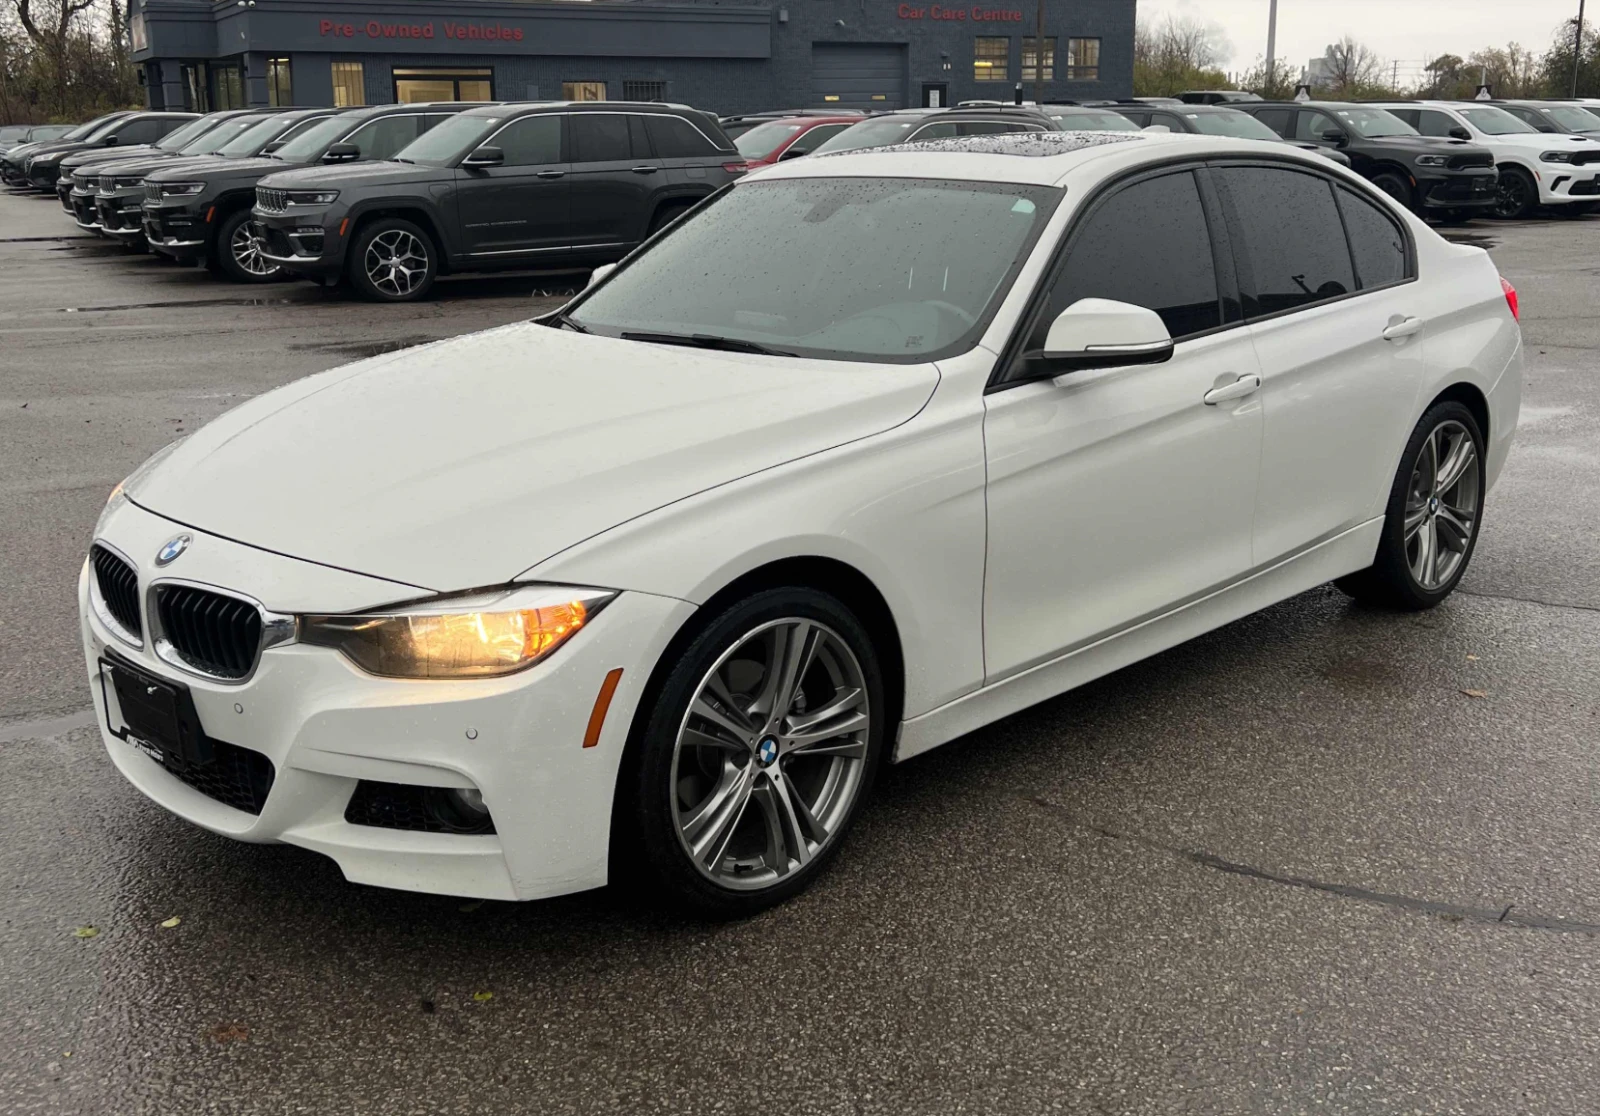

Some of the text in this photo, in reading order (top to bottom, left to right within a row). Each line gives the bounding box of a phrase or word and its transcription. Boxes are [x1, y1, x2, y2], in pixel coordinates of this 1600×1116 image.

[898, 4, 1022, 21] Car Care Centre
[319, 20, 524, 41] Pre-Owned Vehicles
